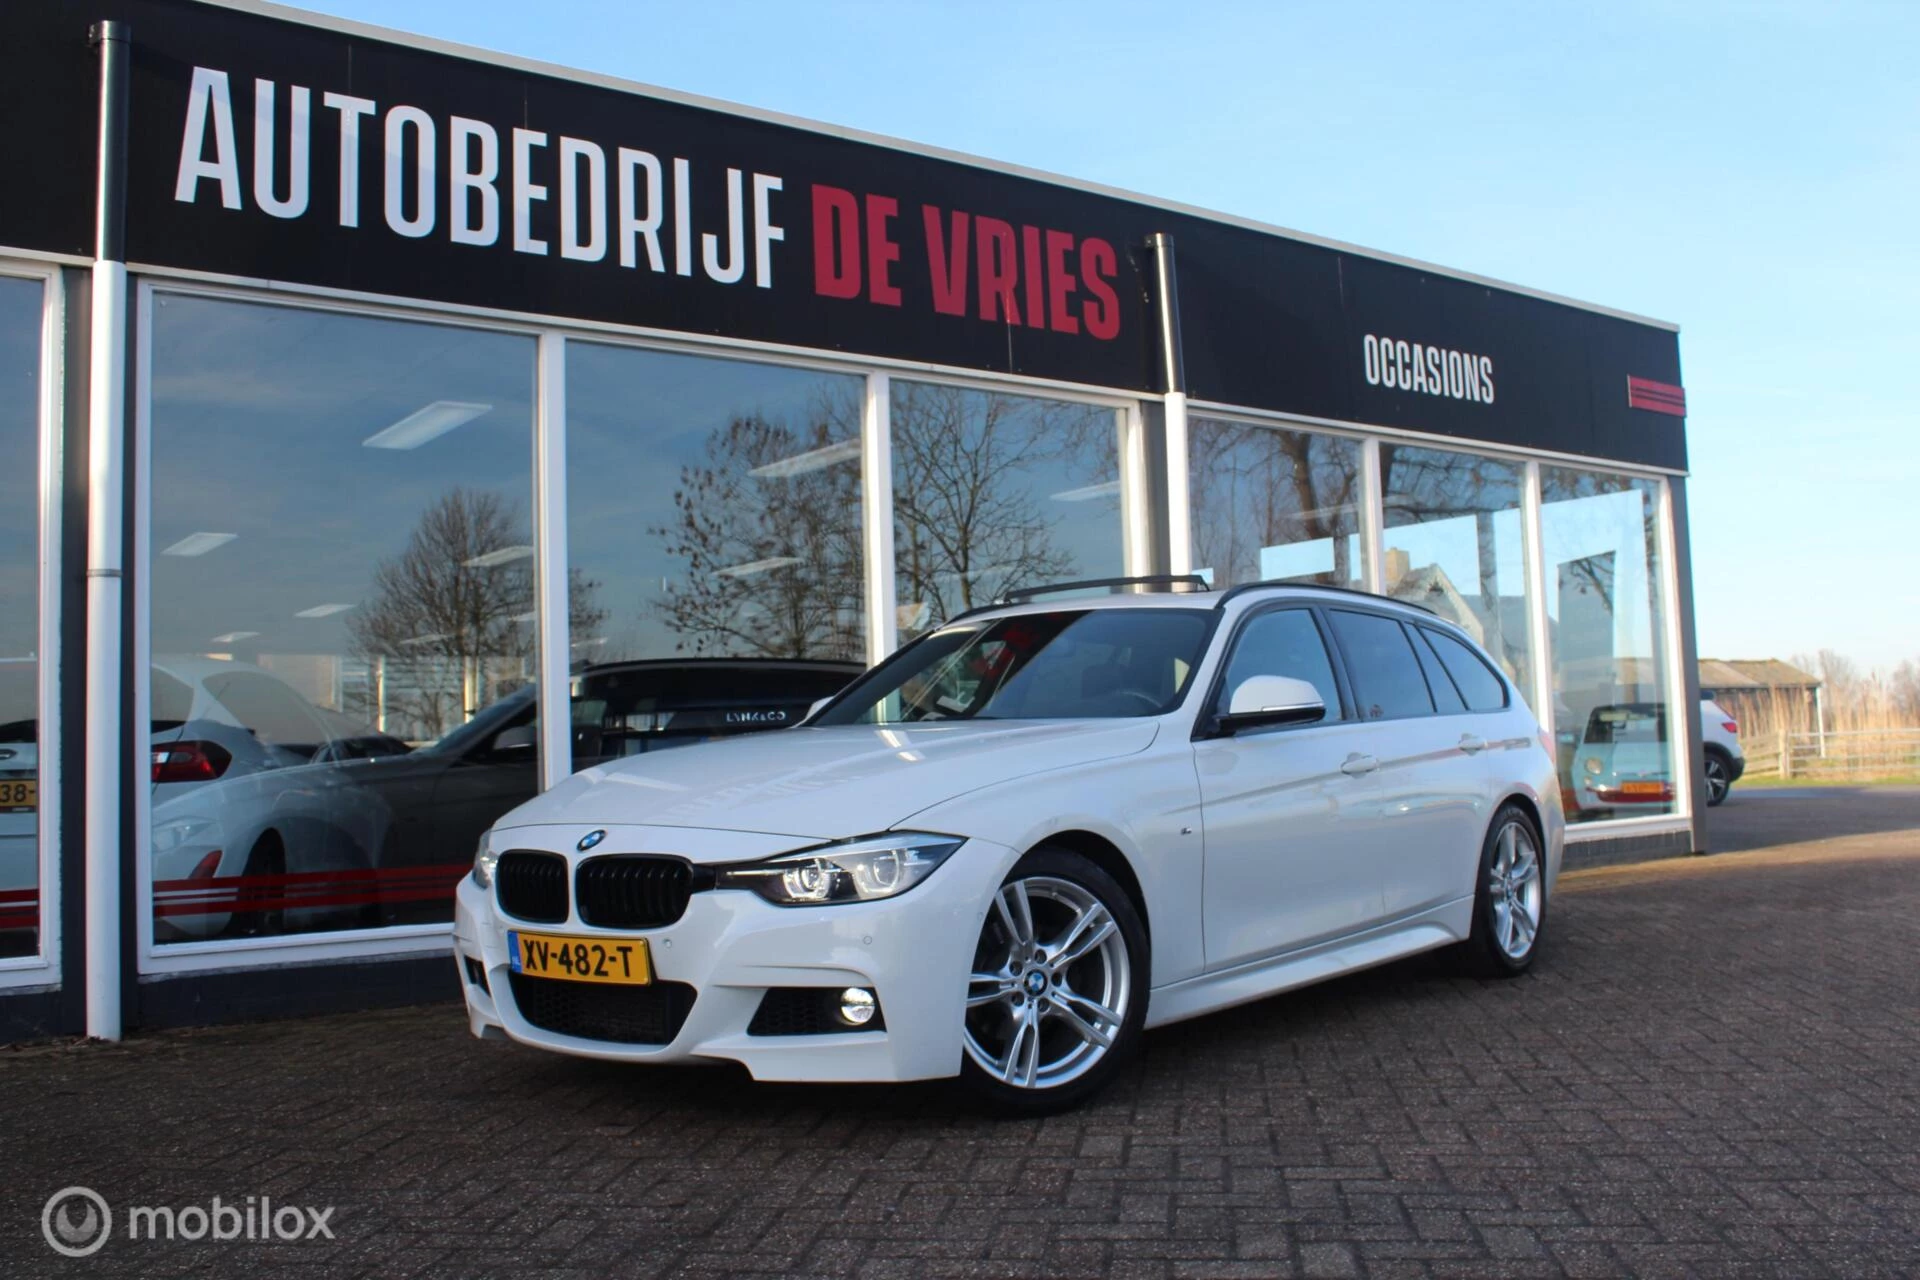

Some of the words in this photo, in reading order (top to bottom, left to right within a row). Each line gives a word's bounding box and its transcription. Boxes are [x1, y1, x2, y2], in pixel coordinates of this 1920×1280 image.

[175, 66, 784, 289] AUTOBEDRIJF
[811, 184, 902, 306] DE
[922, 205, 1120, 340] VRIES
[1364, 334, 1494, 403] OCCASIONS
[524, 940, 632, 977] XV-482-T
